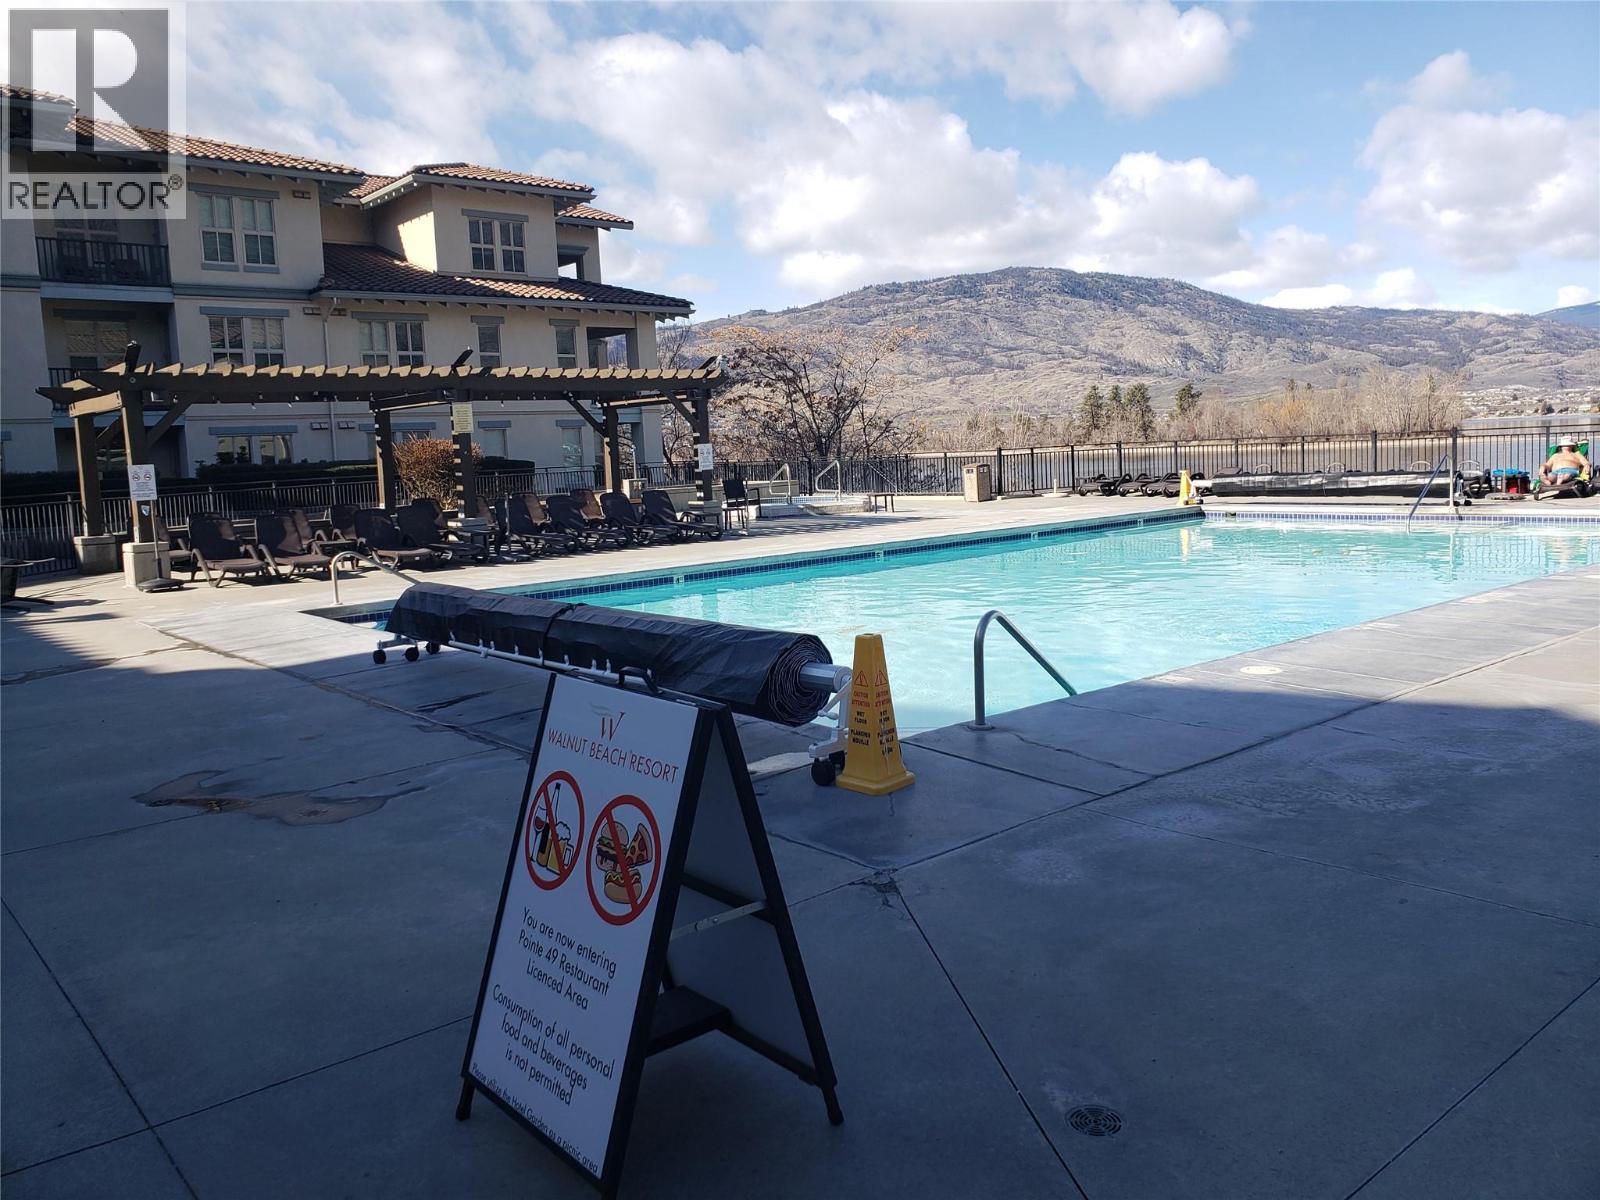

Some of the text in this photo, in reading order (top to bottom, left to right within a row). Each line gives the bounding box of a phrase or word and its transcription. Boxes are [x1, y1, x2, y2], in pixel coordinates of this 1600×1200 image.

[548, 729, 679, 783] WALNUT BEACH RESORT
[601, 712, 626, 742] W
[518, 929, 609, 996] Pointe 49 Restaurant
[523, 907, 617, 979] You are now entering
[526, 958, 588, 1010] Licenced Area
[493, 984, 615, 1080] Consumption of all personal
[501, 1012, 587, 1090] food and beverages
[505, 1044, 573, 1106] is not permitted
[512, 1095, 526, 1115] Hotel
[526, 1107, 548, 1134] Garden
[548, 1129, 556, 1141] as
[557, 1135, 562, 1144] a
[582, 1155, 599, 1174] area
